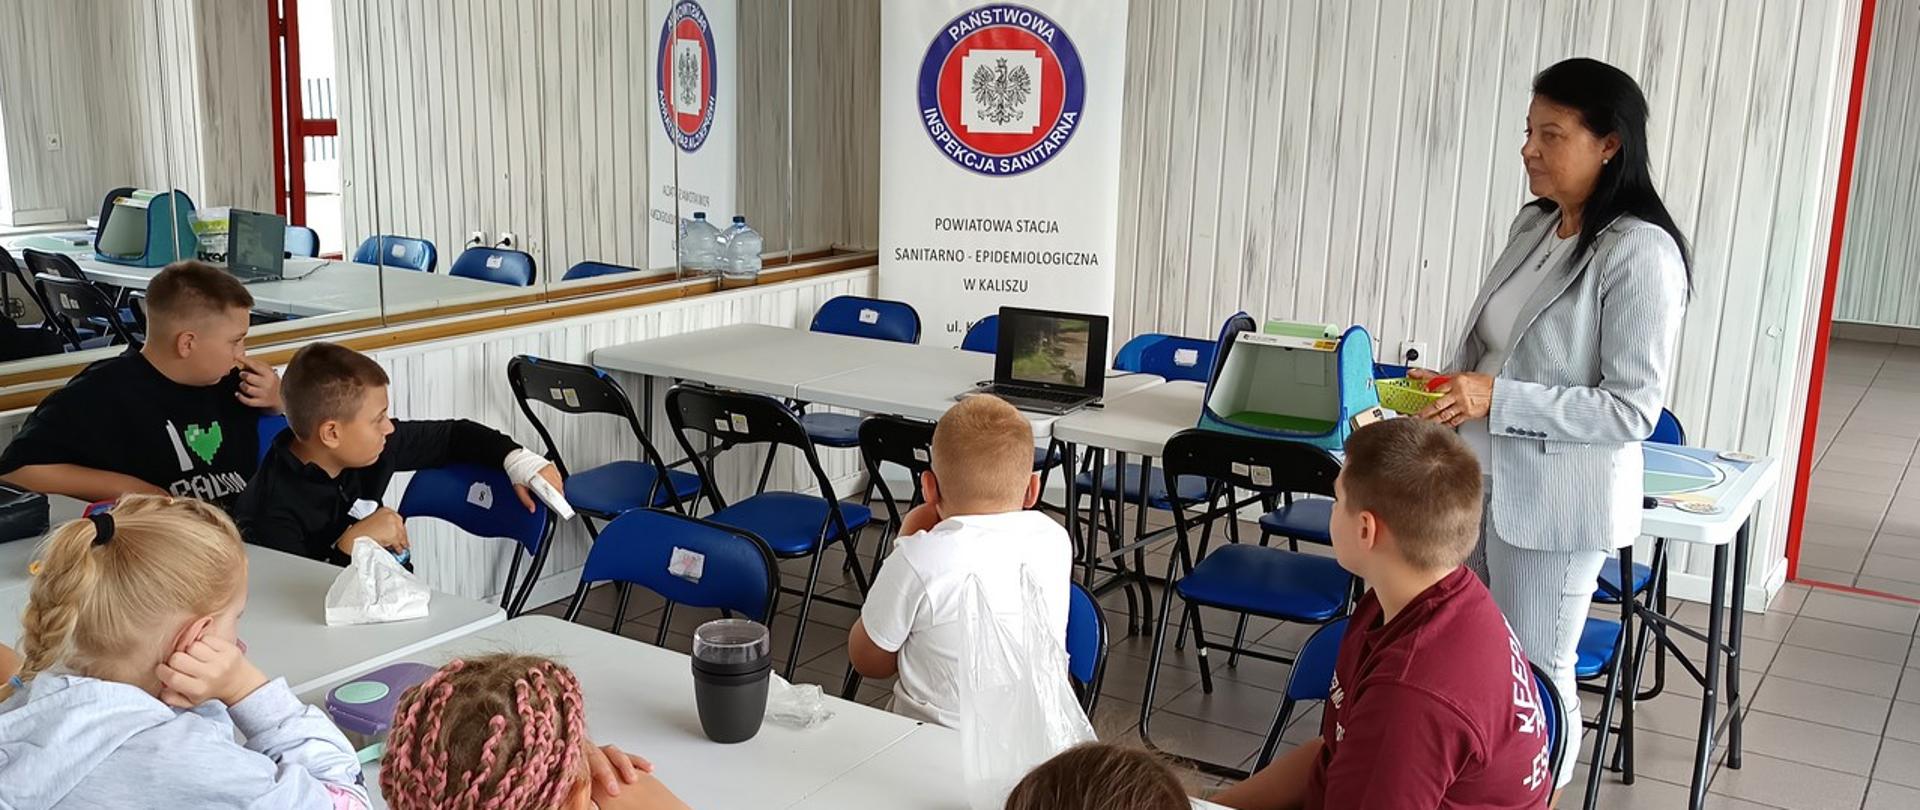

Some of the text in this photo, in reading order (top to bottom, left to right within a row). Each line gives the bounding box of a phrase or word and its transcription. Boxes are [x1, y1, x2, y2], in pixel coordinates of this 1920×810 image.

[948, 8, 1056, 43] PAŃSTWOWA
[924, 107, 1077, 173] INSPEKCJA SANITARNA
[935, 217, 1059, 234] POWIATOWA STACJA
[895, 247, 965, 263] SANITARNO
[975, 249, 1099, 266] EPIDEMIOLOGICZNA
[963, 278, 1029, 293] W KALISZU
[946, 320, 962, 333] ul.
[166, 419, 194, 472] I
[479, 490, 486, 502] 8
